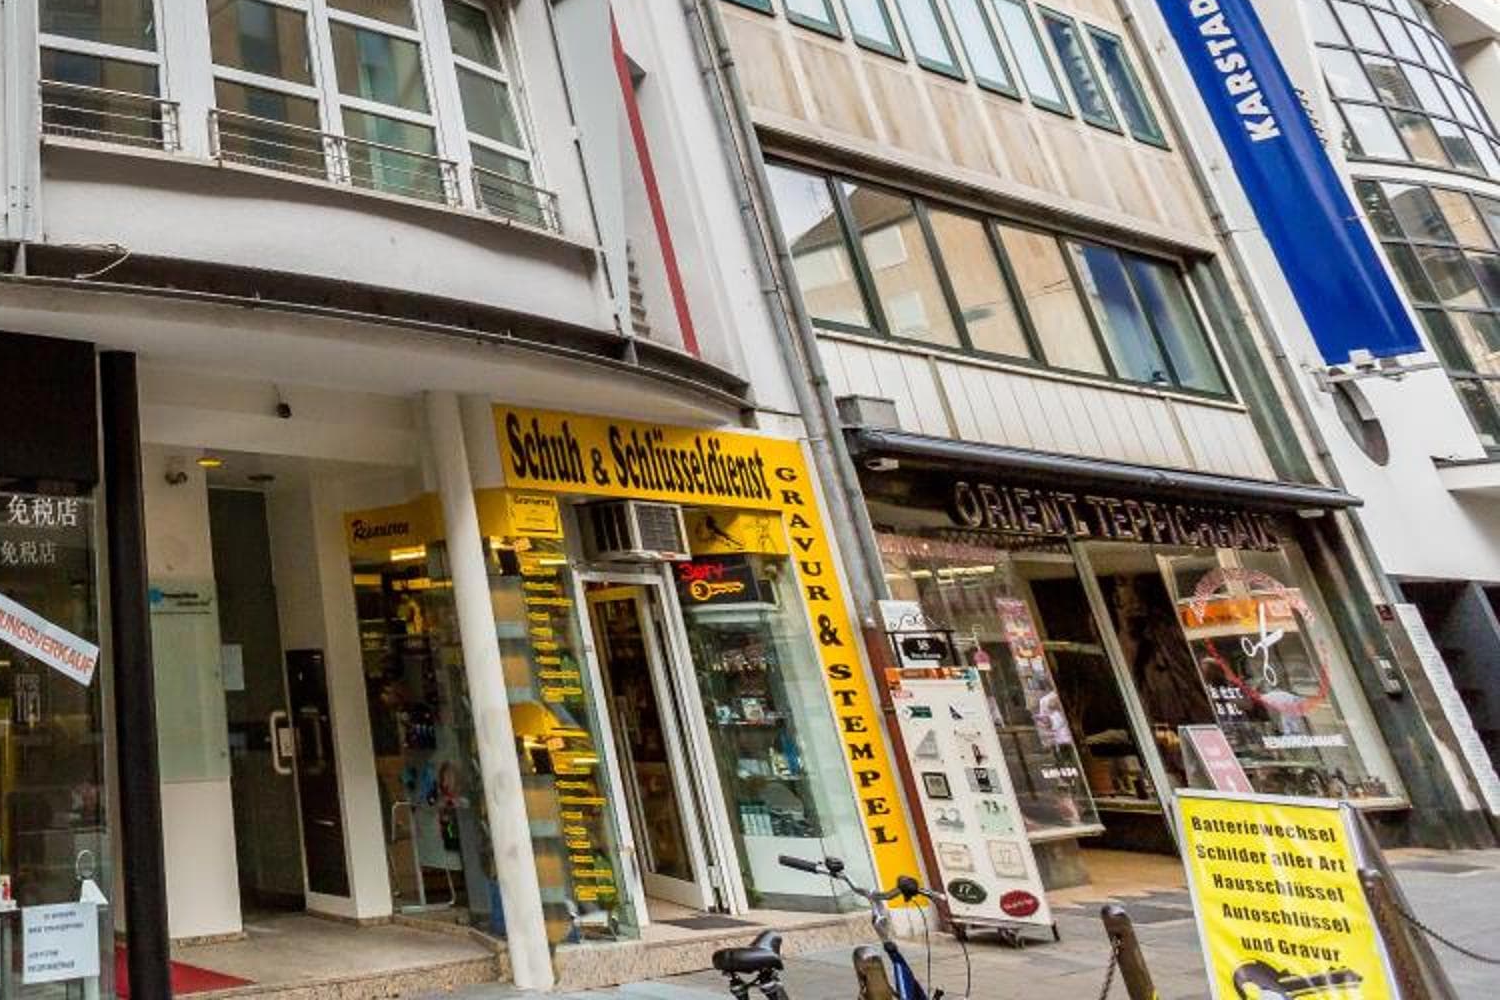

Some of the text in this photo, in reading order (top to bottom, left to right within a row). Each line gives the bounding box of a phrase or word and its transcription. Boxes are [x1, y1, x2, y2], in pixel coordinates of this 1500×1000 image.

[505, 411, 773, 501] Schuh & Schlüsseldienst
[7, 494, 79, 528] 免税店
[775, 466, 831, 602] GRAVUR
[817, 614, 844, 647] &
[827, 662, 899, 846] STEMPEL
[1191, 815, 1337, 843] Batteriewechsel
[1196, 842, 1347, 873] Schilder aller Art
[1213, 873, 1346, 904] Hausschlüssel
[1222, 902, 1351, 934] Autoschlüssel
[1240, 936, 1341, 963] und Gravur
